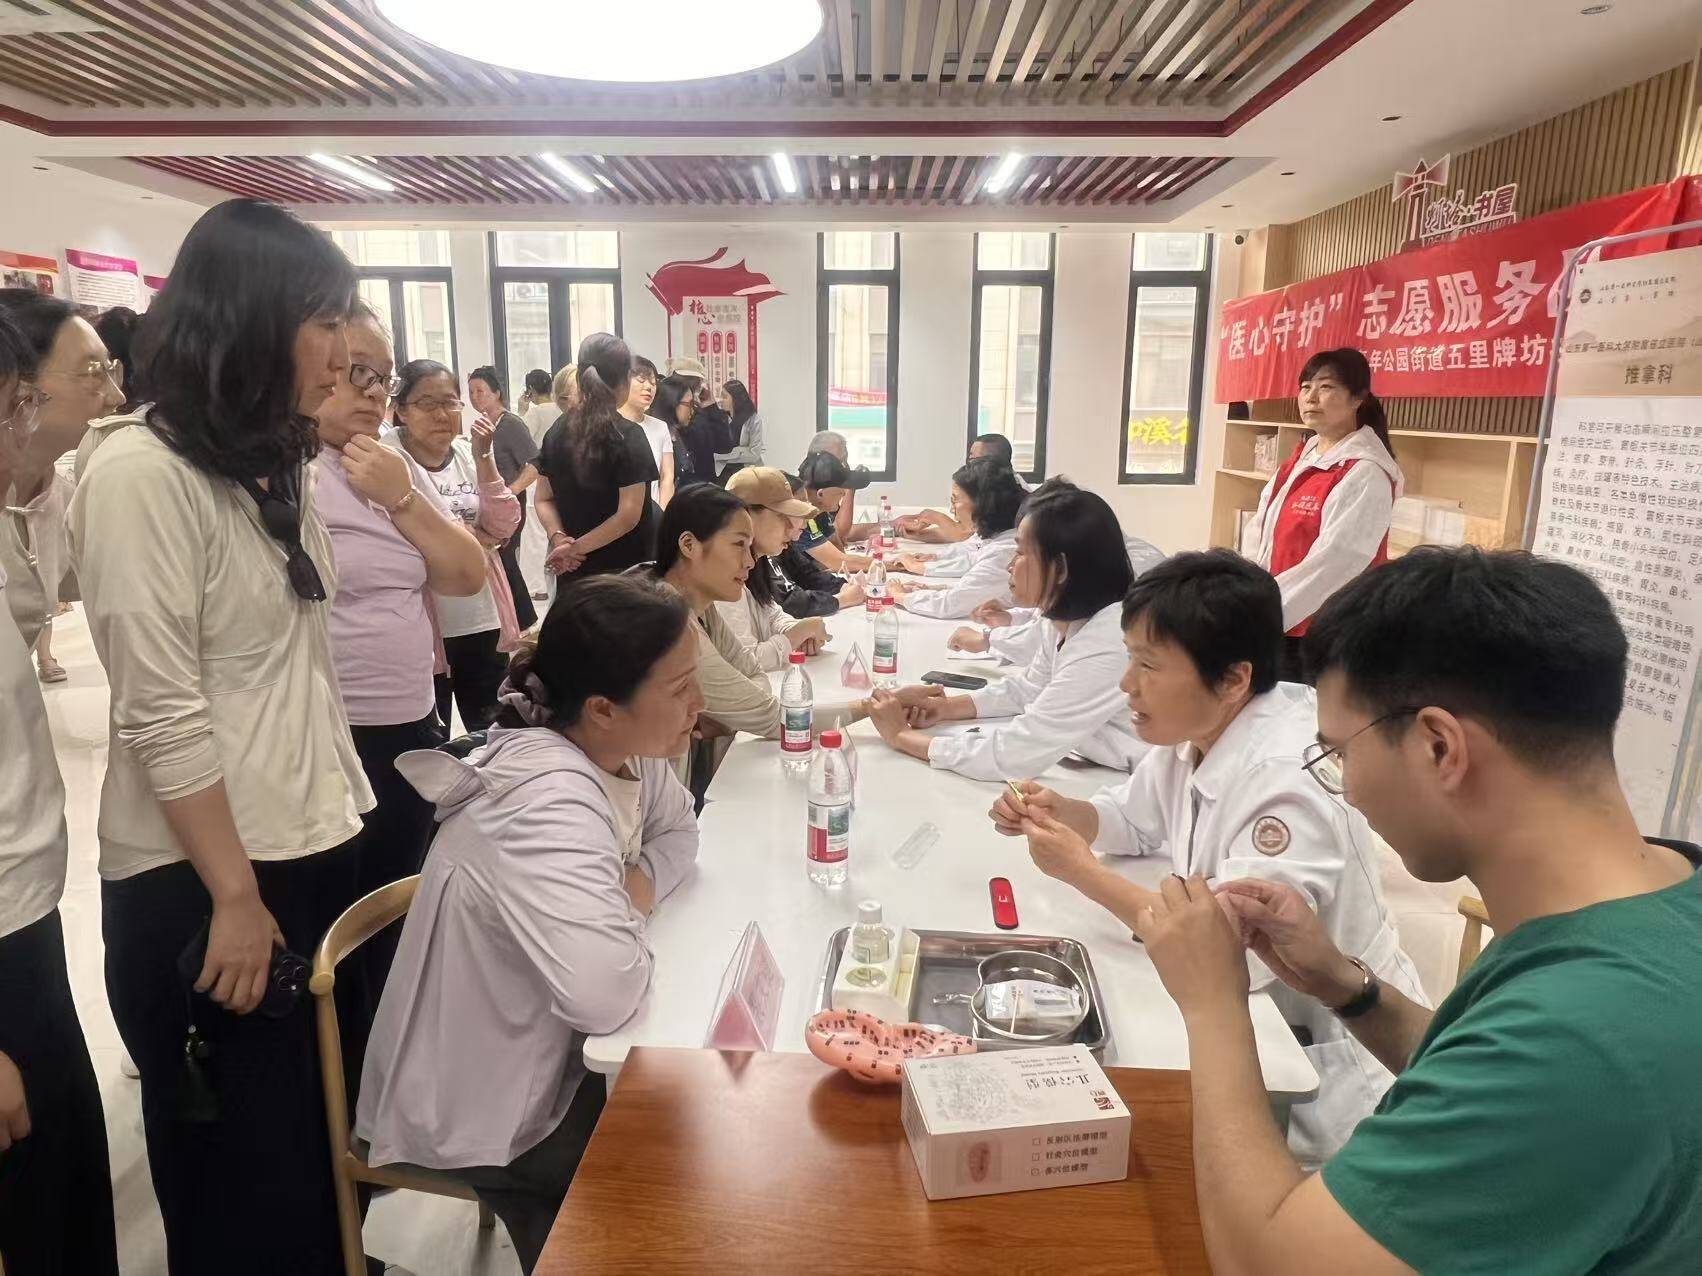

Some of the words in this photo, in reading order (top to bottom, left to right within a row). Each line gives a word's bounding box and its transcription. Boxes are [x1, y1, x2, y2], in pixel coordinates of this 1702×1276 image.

[1359, 333, 1559, 374] 年公园街道五里牌坊
[1624, 363, 1673, 385] 推拿科
